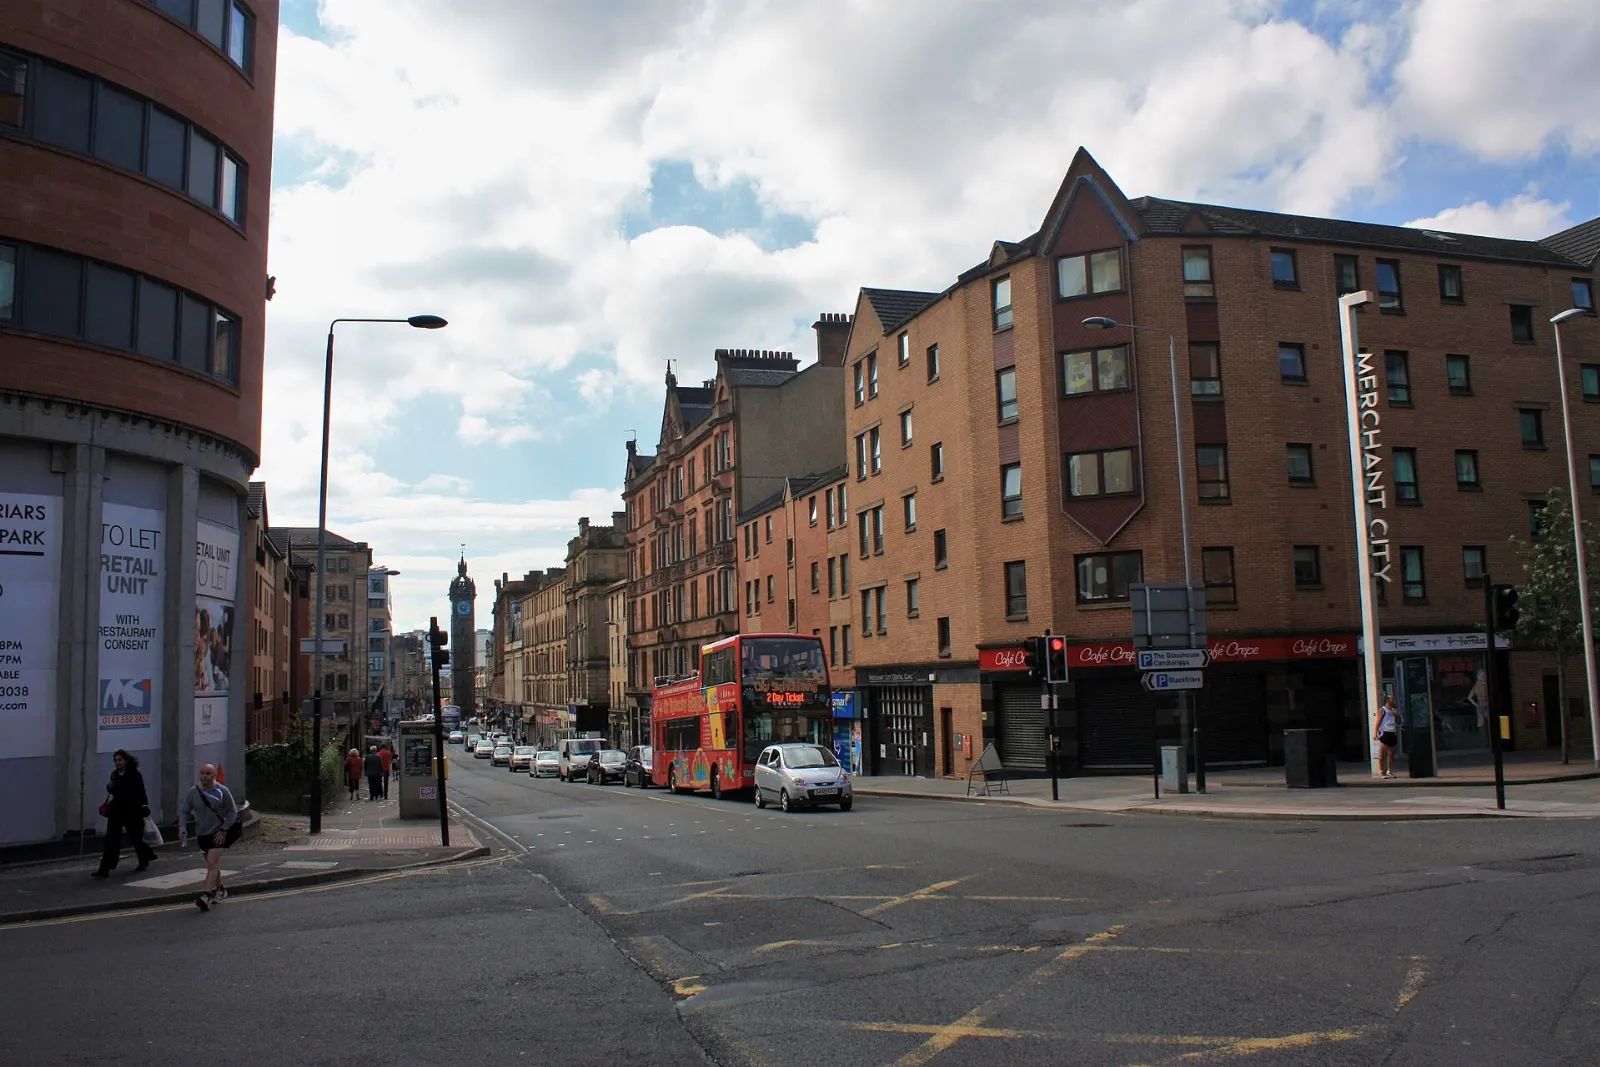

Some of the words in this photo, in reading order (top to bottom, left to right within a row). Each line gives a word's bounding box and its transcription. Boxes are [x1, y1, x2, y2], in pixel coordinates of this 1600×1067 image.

[1356, 353, 1386, 508] MERCHANT
[101, 523, 124, 546] TO
[129, 527, 161, 550] LET
[196, 541, 215, 560] ETAIL
[1370, 518, 1392, 583] CITY
[100, 554, 158, 576] RETAIL
[196, 559, 208, 587] O
[211, 562, 231, 591] LET
[107, 575, 149, 596] UNIT
[115, 614, 140, 625] WITH
[104, 639, 149, 651] CONSENT
[1207, 643, 1224, 660] afé
[1226, 641, 1260, 658] Crepe
[1292, 639, 1317, 656] Café
[1319, 639, 1347, 654] Crepe
[994, 650, 1015, 668] Café
[1079, 648, 1108, 664] Café
[1110, 646, 1136, 662] Crep
[766, 692, 772, 702] 2
[772, 692, 784, 703] Day
[785, 692, 805, 702] Ticket
[102, 716, 119, 725] 0141
